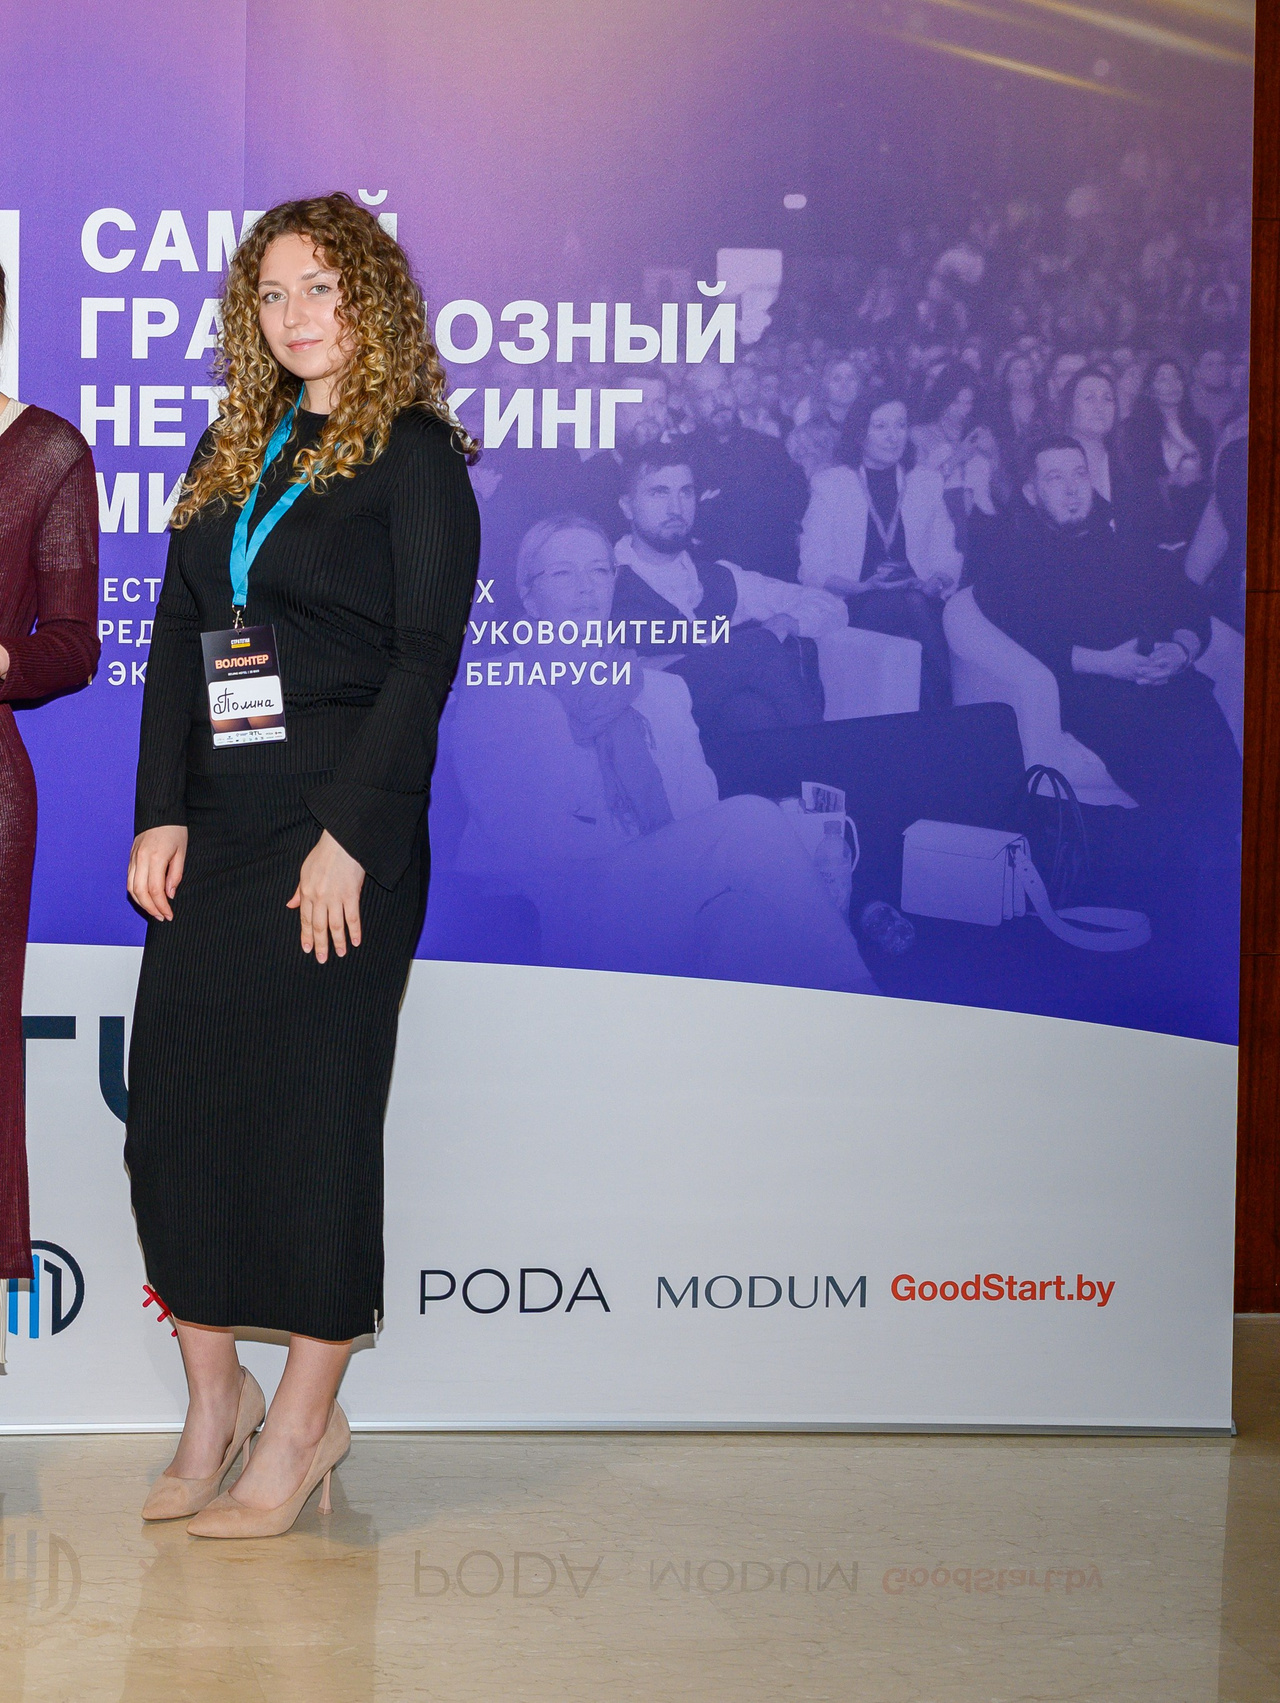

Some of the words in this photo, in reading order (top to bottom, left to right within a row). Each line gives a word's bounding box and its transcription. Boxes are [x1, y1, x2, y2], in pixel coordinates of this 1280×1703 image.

[81, 189, 398, 273] САМ
[80, 280, 736, 365] ГРАОЗНЫЙ
[80, 385, 643, 449] НЕТКИНГ
[465, 615, 730, 648] УКОВОДИТЕЛЕЙ
[215, 654, 269, 670] ВОЛОНТЕР
[466, 661, 632, 687] БЕЛАРУСИ
[213, 688, 274, 714] Полина
[420, 1267, 611, 1316] PODA
[656, 1275, 867, 1309] MODUM
[890, 1273, 1116, 1308] GoodStart.by
